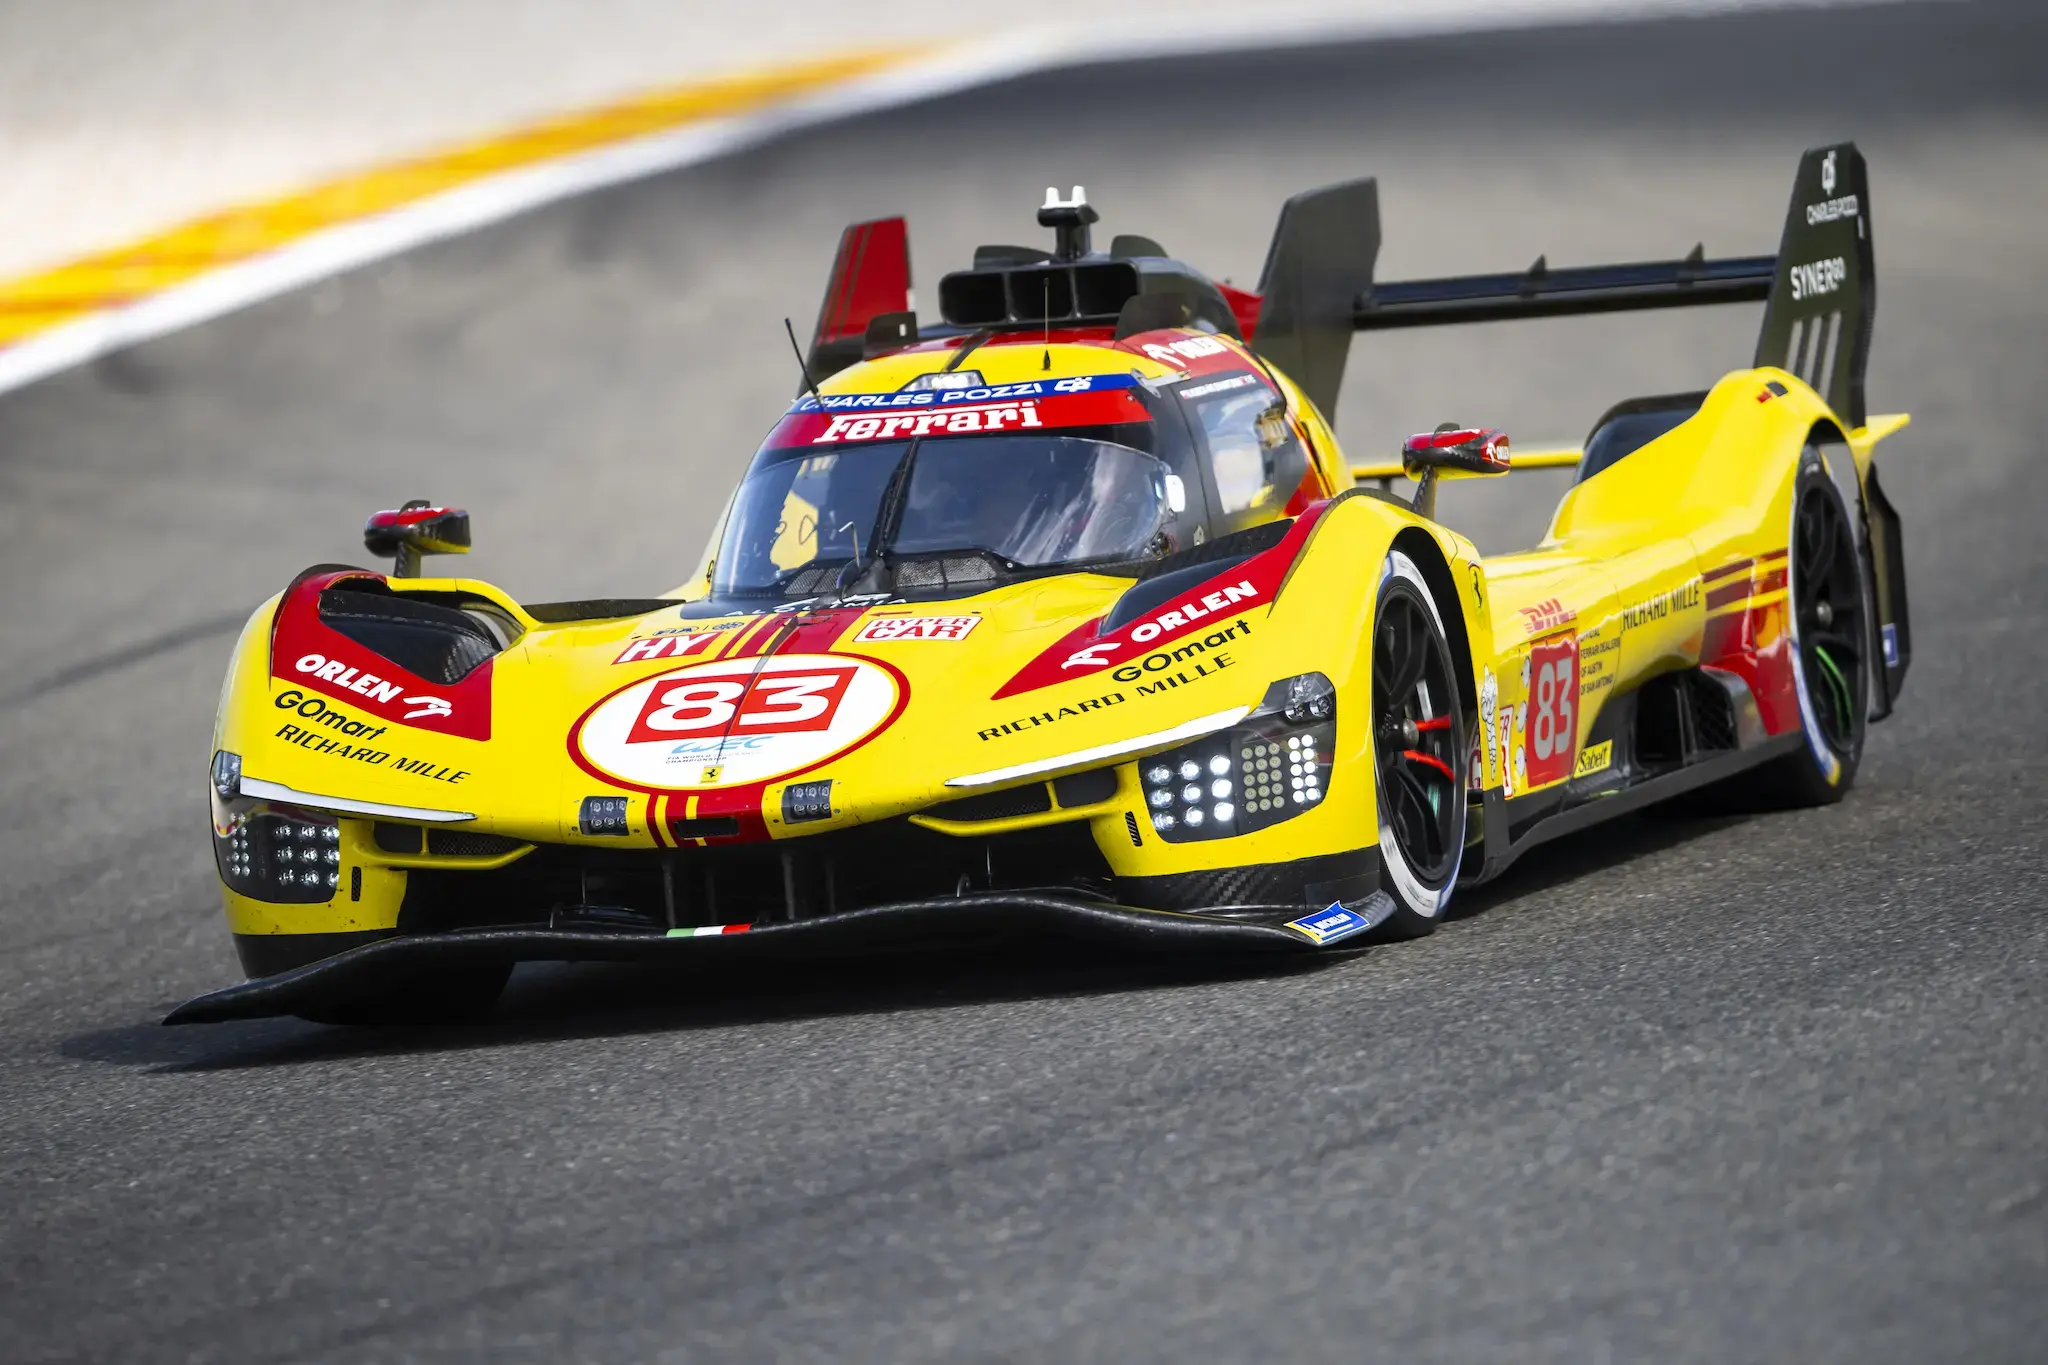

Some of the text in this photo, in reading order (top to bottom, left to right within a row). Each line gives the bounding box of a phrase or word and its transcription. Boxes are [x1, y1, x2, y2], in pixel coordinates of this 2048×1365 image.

[800, 393, 934, 411] CHARLES
[941, 382, 1043, 403] POZZI
[812, 401, 1042, 444] Ferrari
[874, 618, 972, 628] HYPER
[1131, 580, 1259, 643] ORLEN
[1519, 597, 1576, 633] DHL
[1622, 581, 1700, 629] RICHARD MILLE
[617, 632, 718, 663] HY
[865, 625, 963, 639] CAR
[1112, 619, 1252, 683] GOmart
[295, 654, 404, 704] ORLEN
[645, 674, 842, 732] 83
[977, 653, 1236, 741] RICHARD MILLE
[274, 690, 388, 741] GOmart
[1534, 657, 1572, 760] 83
[275, 723, 470, 784] RICHARD MILLE
[1579, 748, 1607, 772] Sabelt
